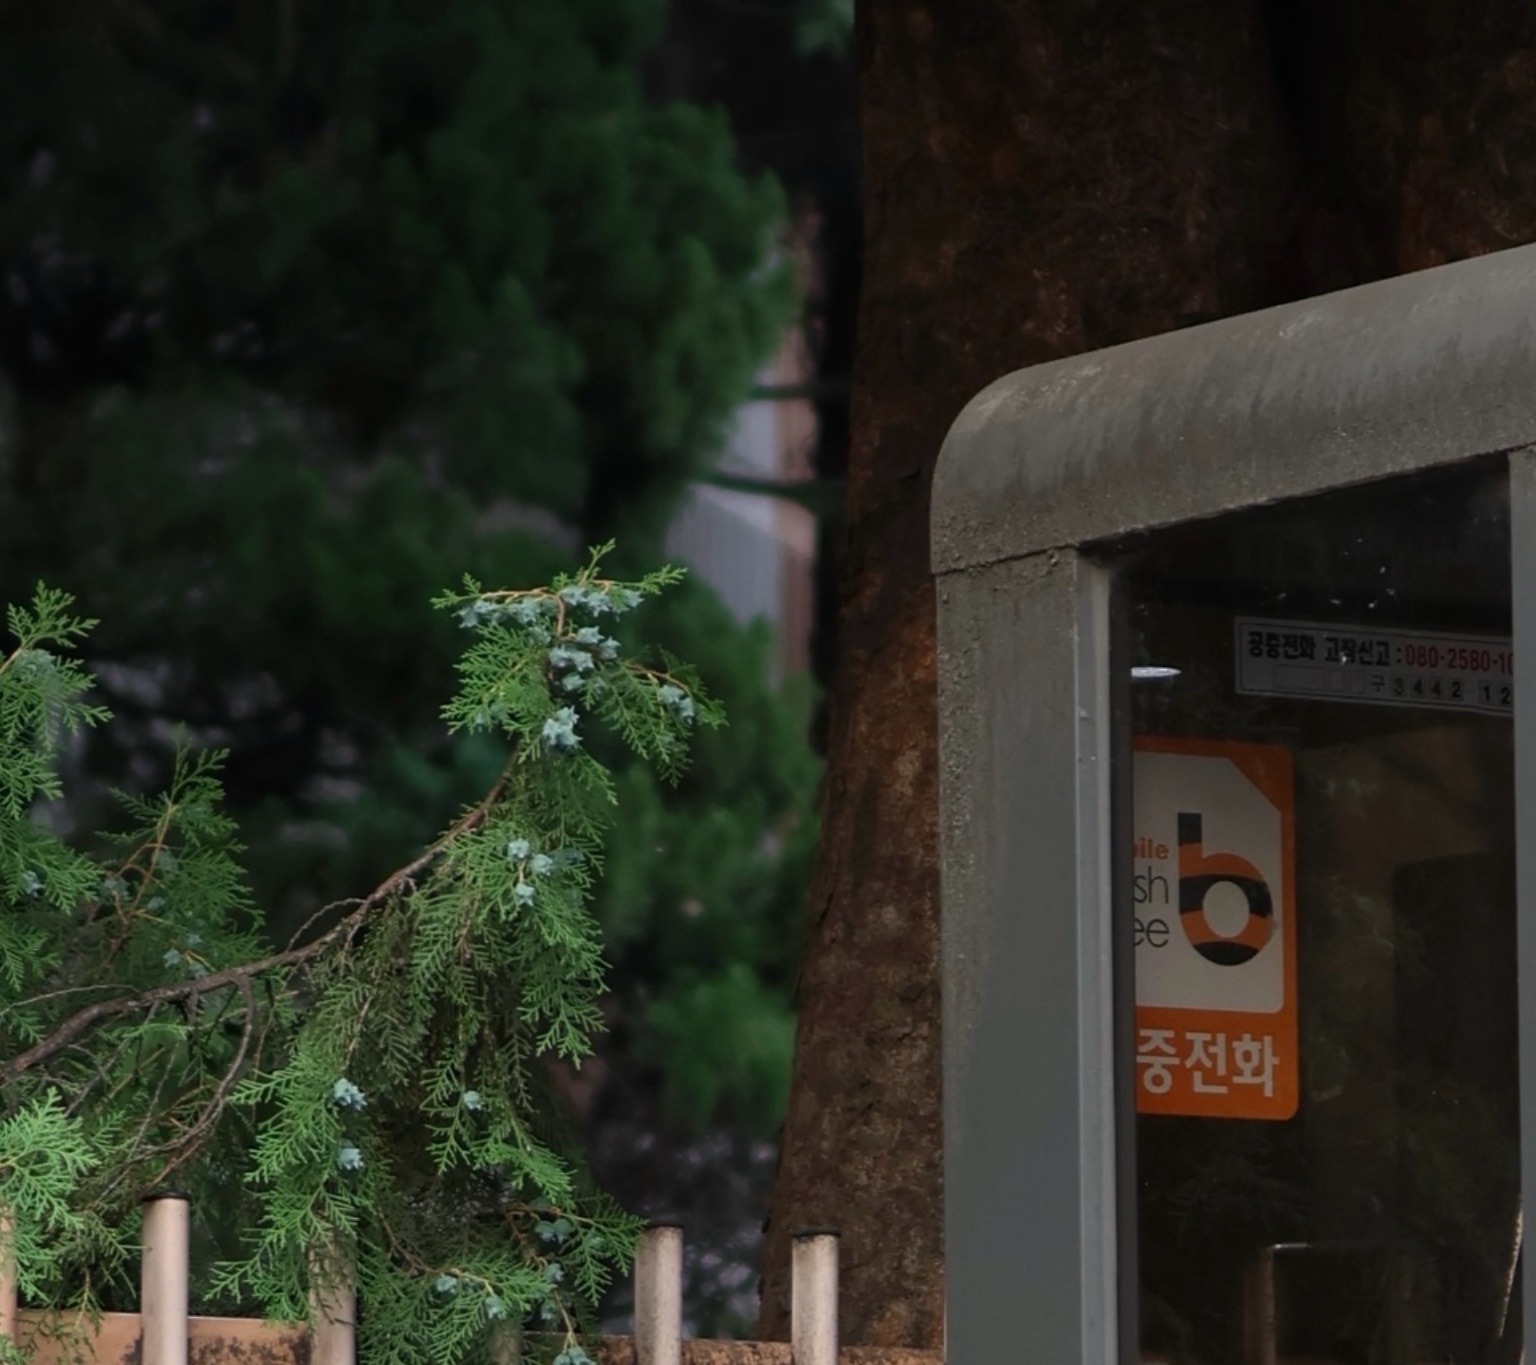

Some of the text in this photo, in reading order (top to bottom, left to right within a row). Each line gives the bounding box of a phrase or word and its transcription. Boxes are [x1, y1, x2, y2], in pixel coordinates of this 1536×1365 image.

[1248, 631, 1316, 660] 공중전화
[1133, 837, 1169, 860] ile
[1136, 1028, 1280, 1097] 중전화
